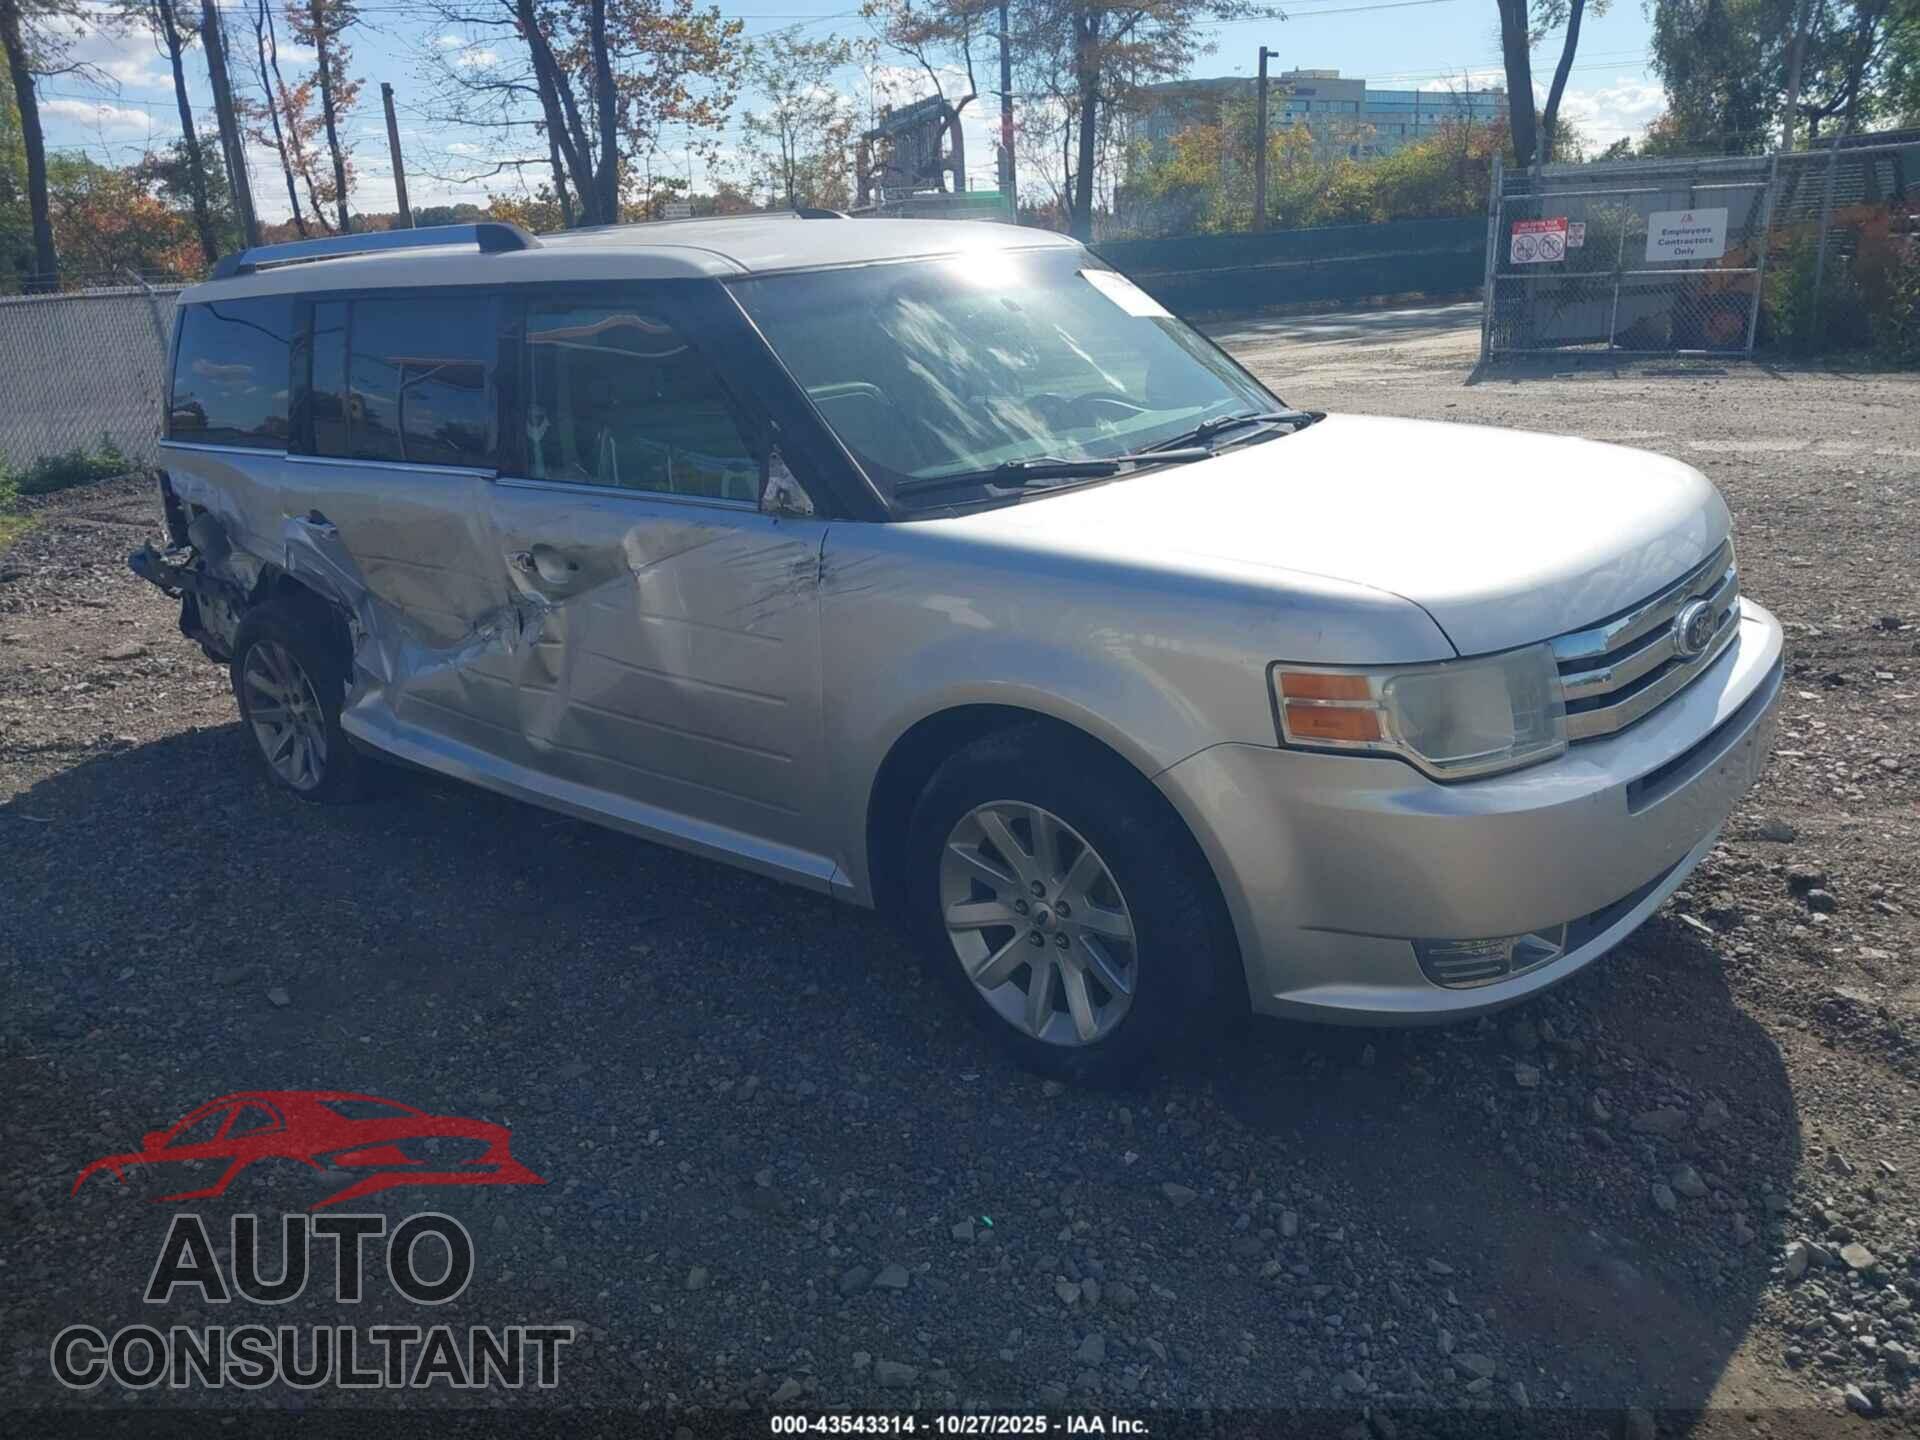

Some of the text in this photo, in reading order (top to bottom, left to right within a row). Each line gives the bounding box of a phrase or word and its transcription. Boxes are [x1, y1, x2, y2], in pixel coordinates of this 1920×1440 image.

[1662, 227, 1711, 236] Employees
[1658, 237, 1713, 246] Contractors
[1674, 247, 1695, 256] Only
